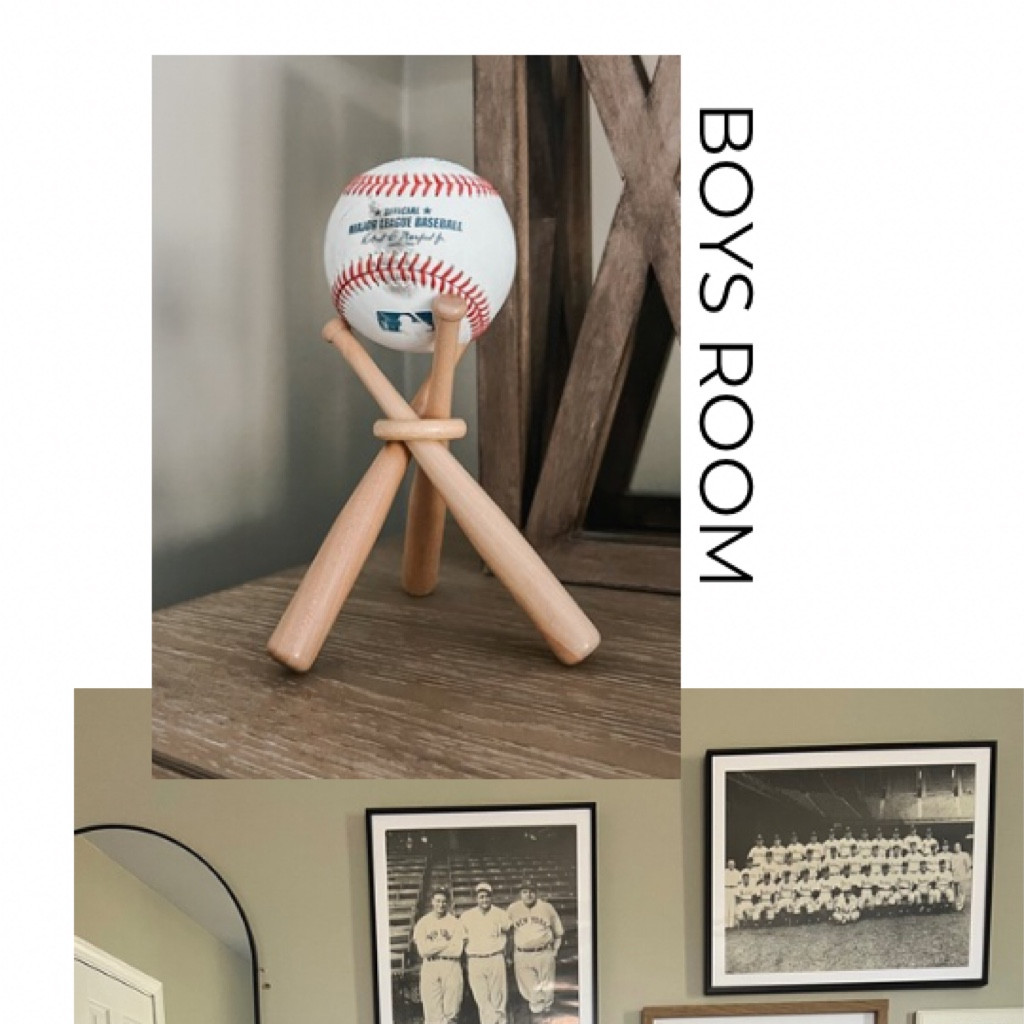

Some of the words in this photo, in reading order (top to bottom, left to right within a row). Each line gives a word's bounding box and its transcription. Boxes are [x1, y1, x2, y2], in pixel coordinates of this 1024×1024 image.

[348, 219, 378, 235] MAJOR
[379, 216, 412, 230] LEAGUE
[414, 217, 463, 232] BASEBALL
